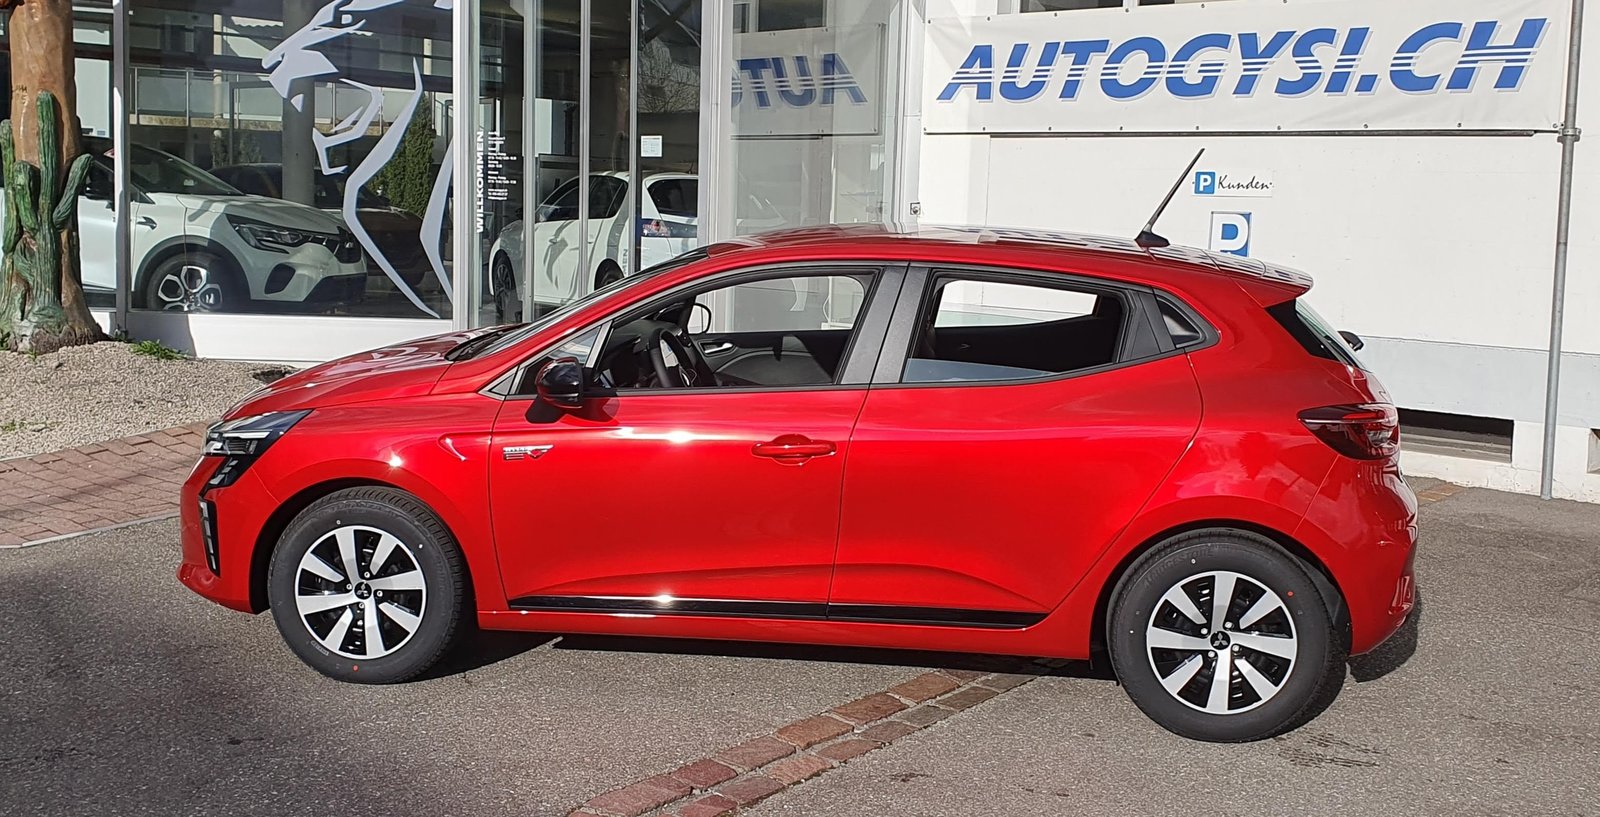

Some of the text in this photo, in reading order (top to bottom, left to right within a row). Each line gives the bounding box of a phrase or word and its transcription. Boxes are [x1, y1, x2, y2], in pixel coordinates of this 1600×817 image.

[937, 17, 1547, 102] AUTOGYSI.CH
[476, 131, 484, 233] WILLKOMMEN
[1199, 174, 1269, 191] P Kunden
[1211, 213, 1249, 252] P
